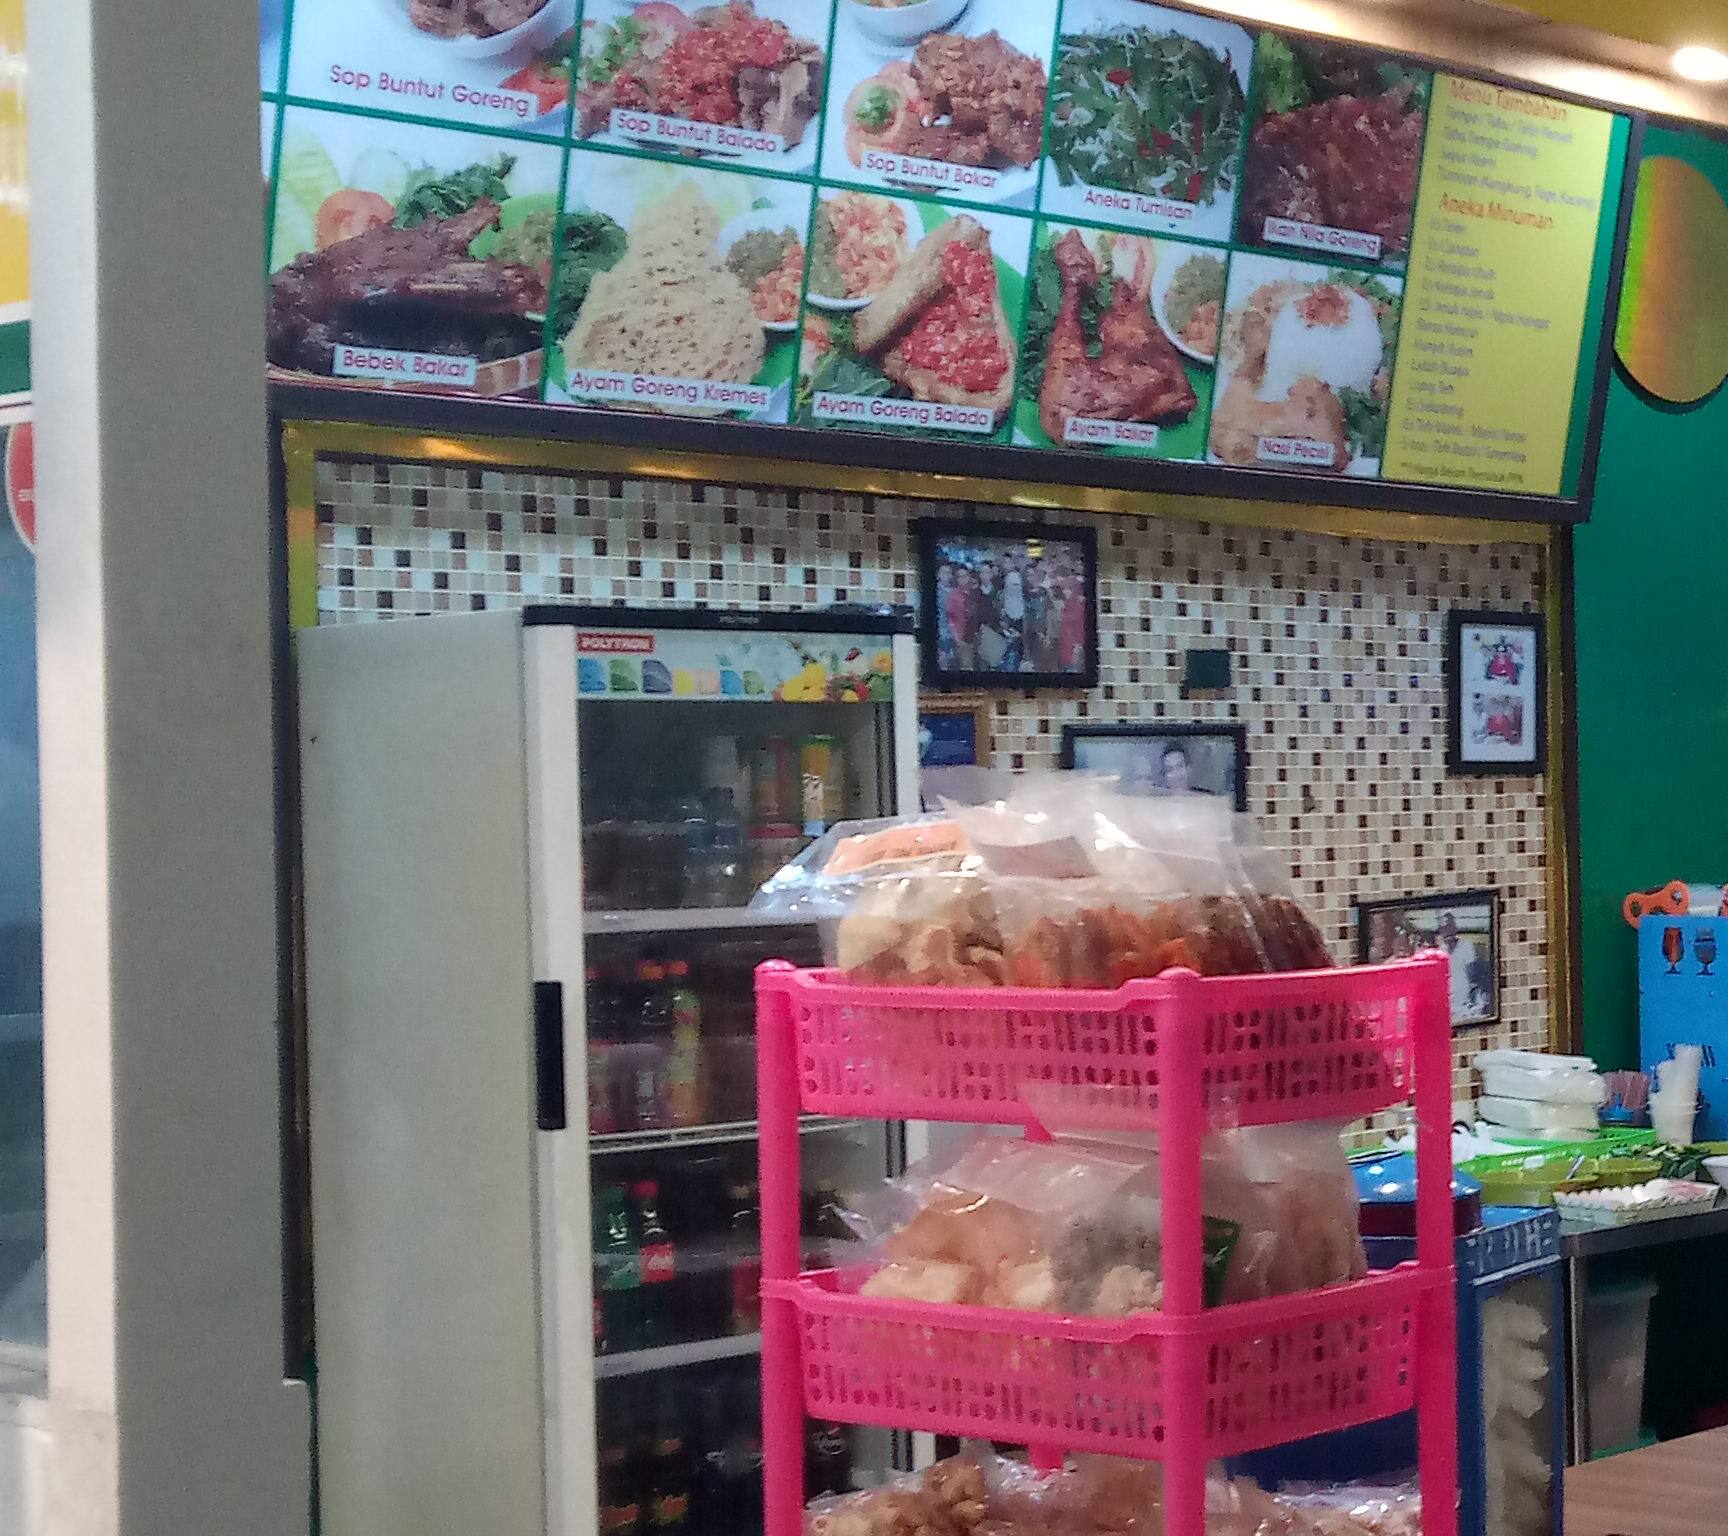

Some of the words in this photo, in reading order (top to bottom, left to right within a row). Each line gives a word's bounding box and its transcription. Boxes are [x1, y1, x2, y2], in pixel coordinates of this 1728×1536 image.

[330, 65, 370, 90] Sop
[378, 72, 445, 99] Buntut
[452, 85, 529, 117] Goreng
[1450, 79, 1491, 105] Menu
[617, 112, 650, 133] Sop
[656, 118, 712, 142] Buntut
[717, 128, 776, 152] Balado
[866, 153, 896, 172] Sop
[902, 159, 949, 180] Buntut
[955, 168, 997, 188] Bakar
[1085, 189, 1130, 210] Aneka
[1136, 197, 1192, 219] Tumisan
[1439, 192, 1484, 218] Aneka
[1488, 200, 1553, 230] Minuman
[1329, 231, 1377, 254] Goreng
[343, 349, 405, 372] Bebek
[413, 356, 469, 377] Bakar
[572, 371, 625, 392] Ayam
[632, 376, 698, 402] Goreng
[704, 383, 768, 404] Kremes
[818, 396, 864, 414] Ayam
[871, 400, 930, 423] Goreng
[935, 406, 988, 425] Balado
[1069, 420, 1109, 437] Ayam
[1115, 423, 1154, 441] Bakar
[1263, 439, 1291, 455] Nasi
